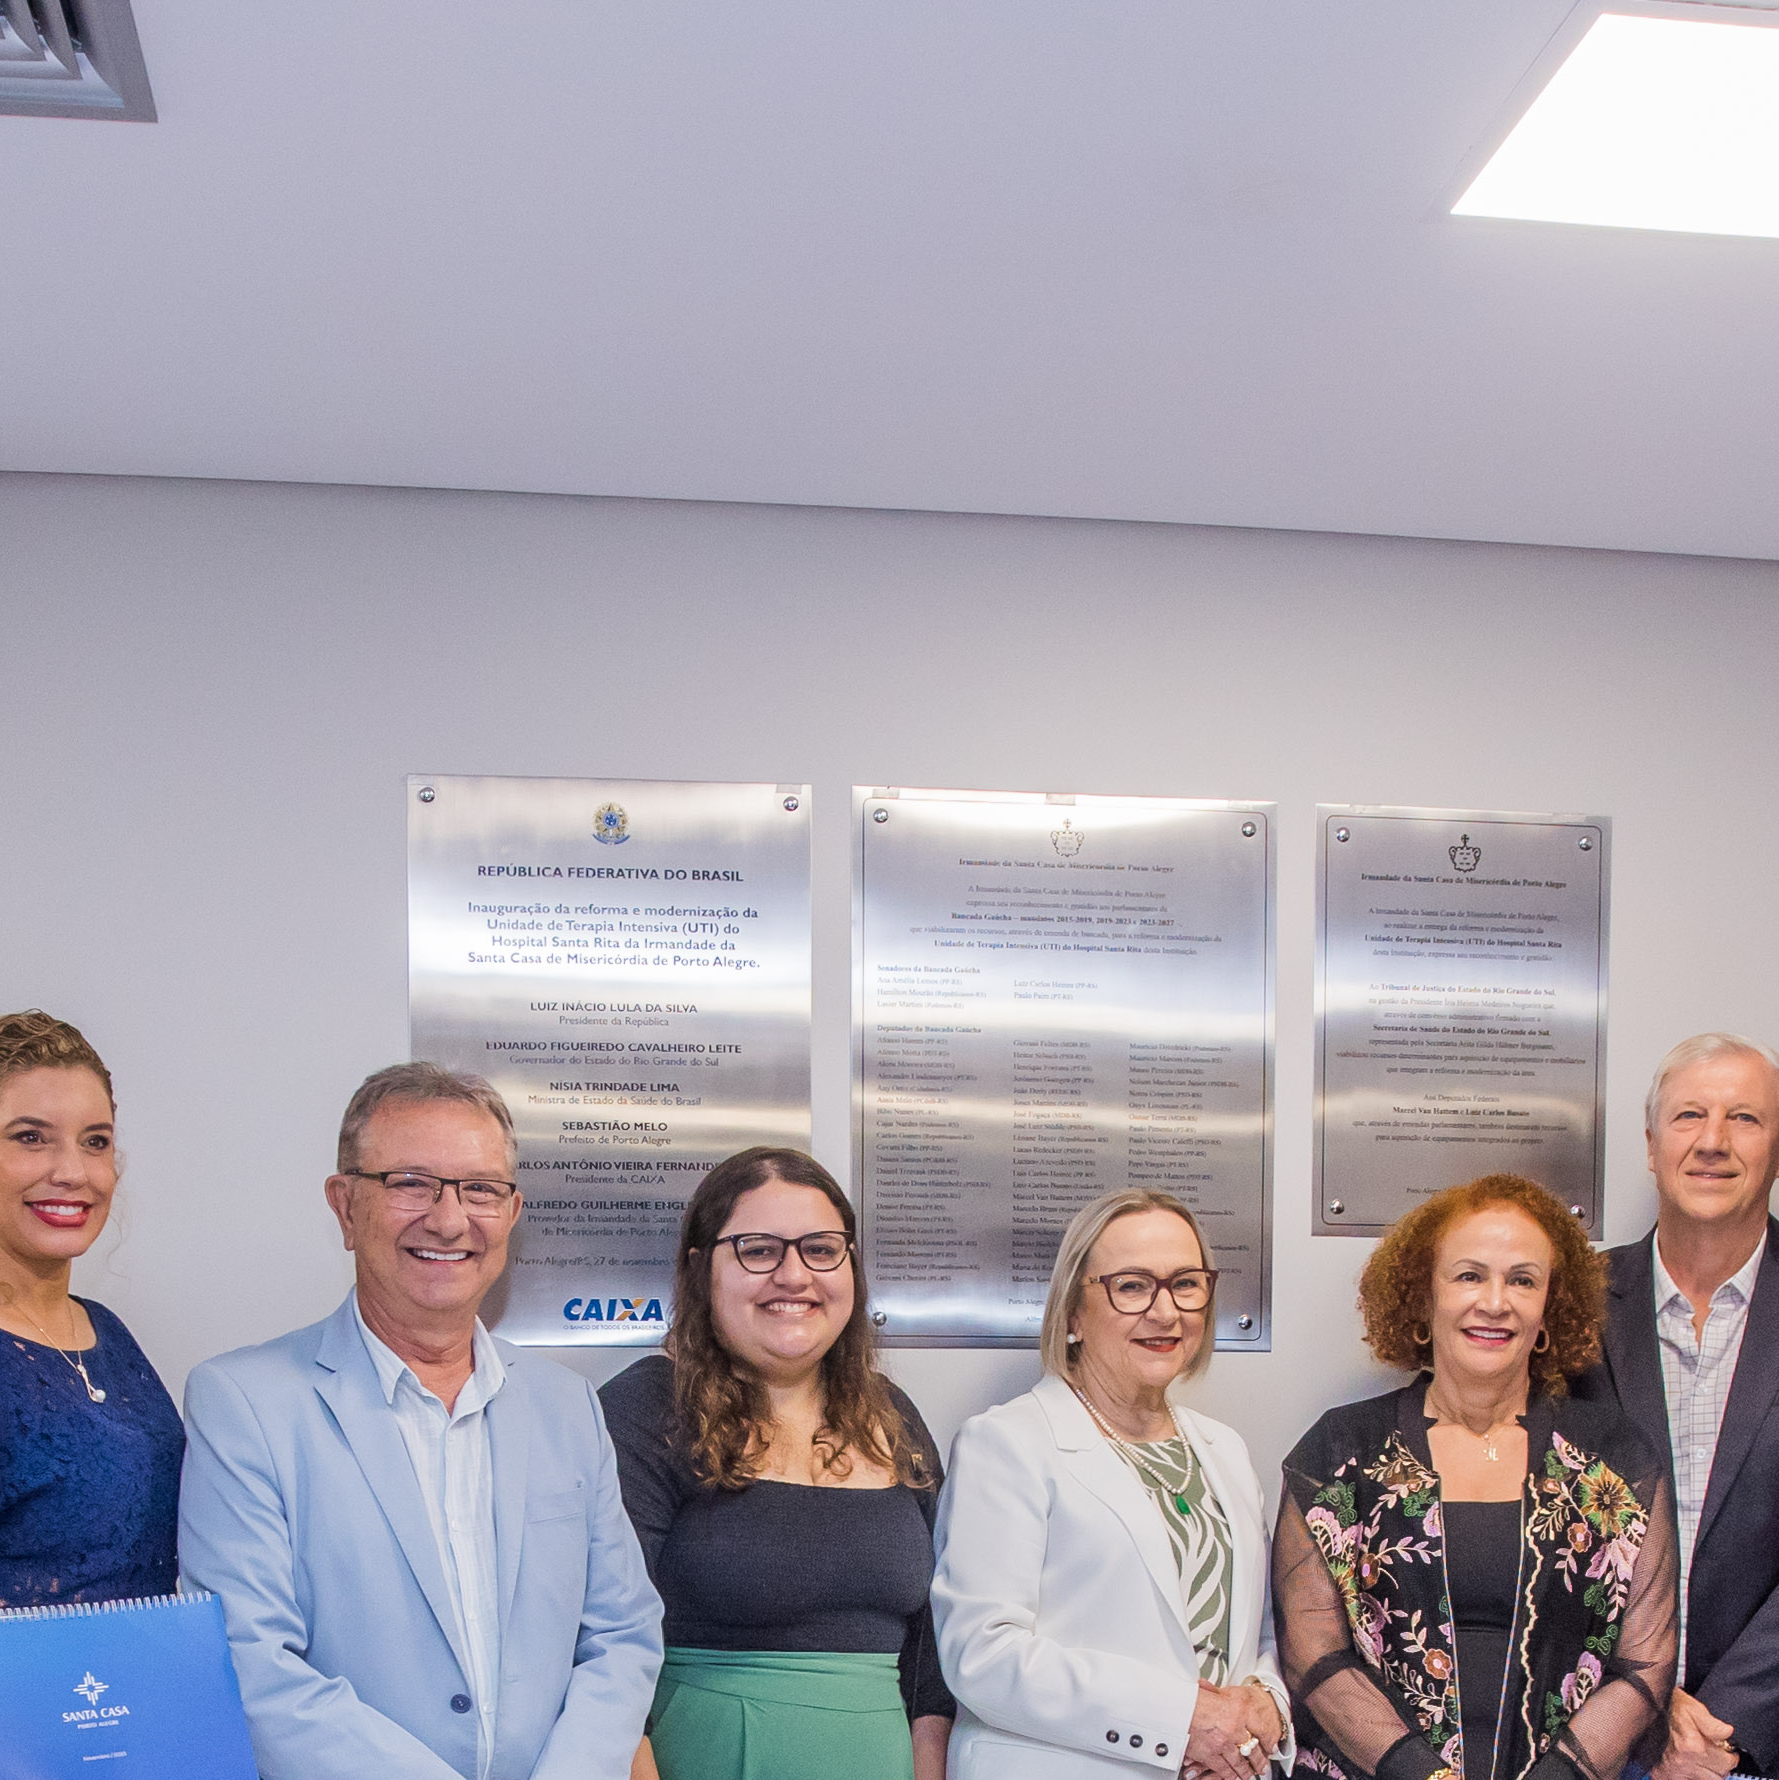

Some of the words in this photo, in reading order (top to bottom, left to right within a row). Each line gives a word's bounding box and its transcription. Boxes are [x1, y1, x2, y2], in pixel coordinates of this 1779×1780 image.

[477, 863, 563, 877] REPÚBLICA
[567, 867, 659, 879] FEDERATIVA
[663, 869, 687, 879] DO
[691, 870, 744, 881] BRASIL
[467, 902, 550, 916] Inauguração
[554, 903, 570, 913] da
[574, 903, 628, 914] reforma
[632, 907, 640, 915] e
[644, 905, 739, 919] modernização
[742, 907, 758, 917] da
[486, 919, 543, 929] Unidade
[546, 920, 563, 930] de
[564, 920, 614, 934] Terapia
[618, 921, 678, 932] Intensiva
[681, 922, 719, 935] (UTI)
[722, 923, 740, 933] do
[491, 935, 547, 949] Hospital
[551, 936, 589, 947] Santa
[593, 937, 620, 947] Rita
[623, 938, 640, 948] da
[643, 938, 716, 949] Irmandade
[719, 940, 736, 949] da
[467, 952, 505, 962] Santa
[509, 952, 542, 963] Casa
[546, 953, 562, 963] de
[566, 954, 648, 964] Misericórdia
[652, 955, 668, 965] de
[672, 955, 710, 966] Porto
[712, 956, 760, 969] Alegre.
[529, 1002, 558, 1010] LUIZ
[561, 1000, 606, 1011] INÁCIO
[609, 1003, 642, 1011] LULA
[644, 1004, 662, 1012] DA
[665, 1004, 698, 1012] SILVA
[558, 1015, 608, 1024] Presidente
[610, 1017, 622, 1025] da
[624, 1016, 669, 1028] República
[485, 1041, 547, 1050] EDUARDO
[550, 1042, 625, 1051] FIGUEIREDO
[627, 1043, 705, 1052] CAVALHEIRO
[708, 1044, 742, 1053] LEITE
[509, 1055, 564, 1063] Governador
[569, 1056, 581, 1064] do
[584, 1055, 615, 1064] Estado
[618, 1056, 630, 1064] do
[633, 1056, 649, 1064] Rio
[652, 1056, 686, 1065] Grande
[690, 1057, 702, 1065] do
[705, 1057, 718, 1066] Sul
[550, 1081, 581, 1090] NÍSIA
[586, 1082, 647, 1091] TRINDADE
[650, 1083, 680, 1091] LIMA
[527, 1095, 565, 1103] Ministra
[582, 1095, 614, 1104] Estado
[616, 1096, 628, 1104] da
[629, 1096, 658, 1105] Saúde
[660, 1097, 673, 1105] do
[675, 1097, 701, 1105] Brasil
[561, 1120, 630, 1130] SEBASTIÃO
[633, 1122, 668, 1130] MELO
[558, 1134, 595, 1143] Prefeito
[597, 1135, 609, 1143] de
[612, 1135, 639, 1143] Porto
[640, 1136, 671, 1146] Alegre
[552, 1158, 612, 1170] ANTÔNIO
[614, 1161, 652, 1170] VIEIRA
[656, 1162, 718, 1172] FERNAND
[564, 1174, 614, 1183] Presidente
[616, 1174, 628, 1183] da
[630, 1175, 665, 1183] CAIXA
[522, 1200, 578, 1209] ALFREDO
[580, 1201, 652, 1209] GUILHERME
[654, 1201, 690, 1210] ENGL
[659, 1228, 682, 1239] Aleg
[563, 1298, 664, 1321] CAIXA
[62, 1710, 99, 1722] SANTA
[100, 1706, 130, 1718] CASA
